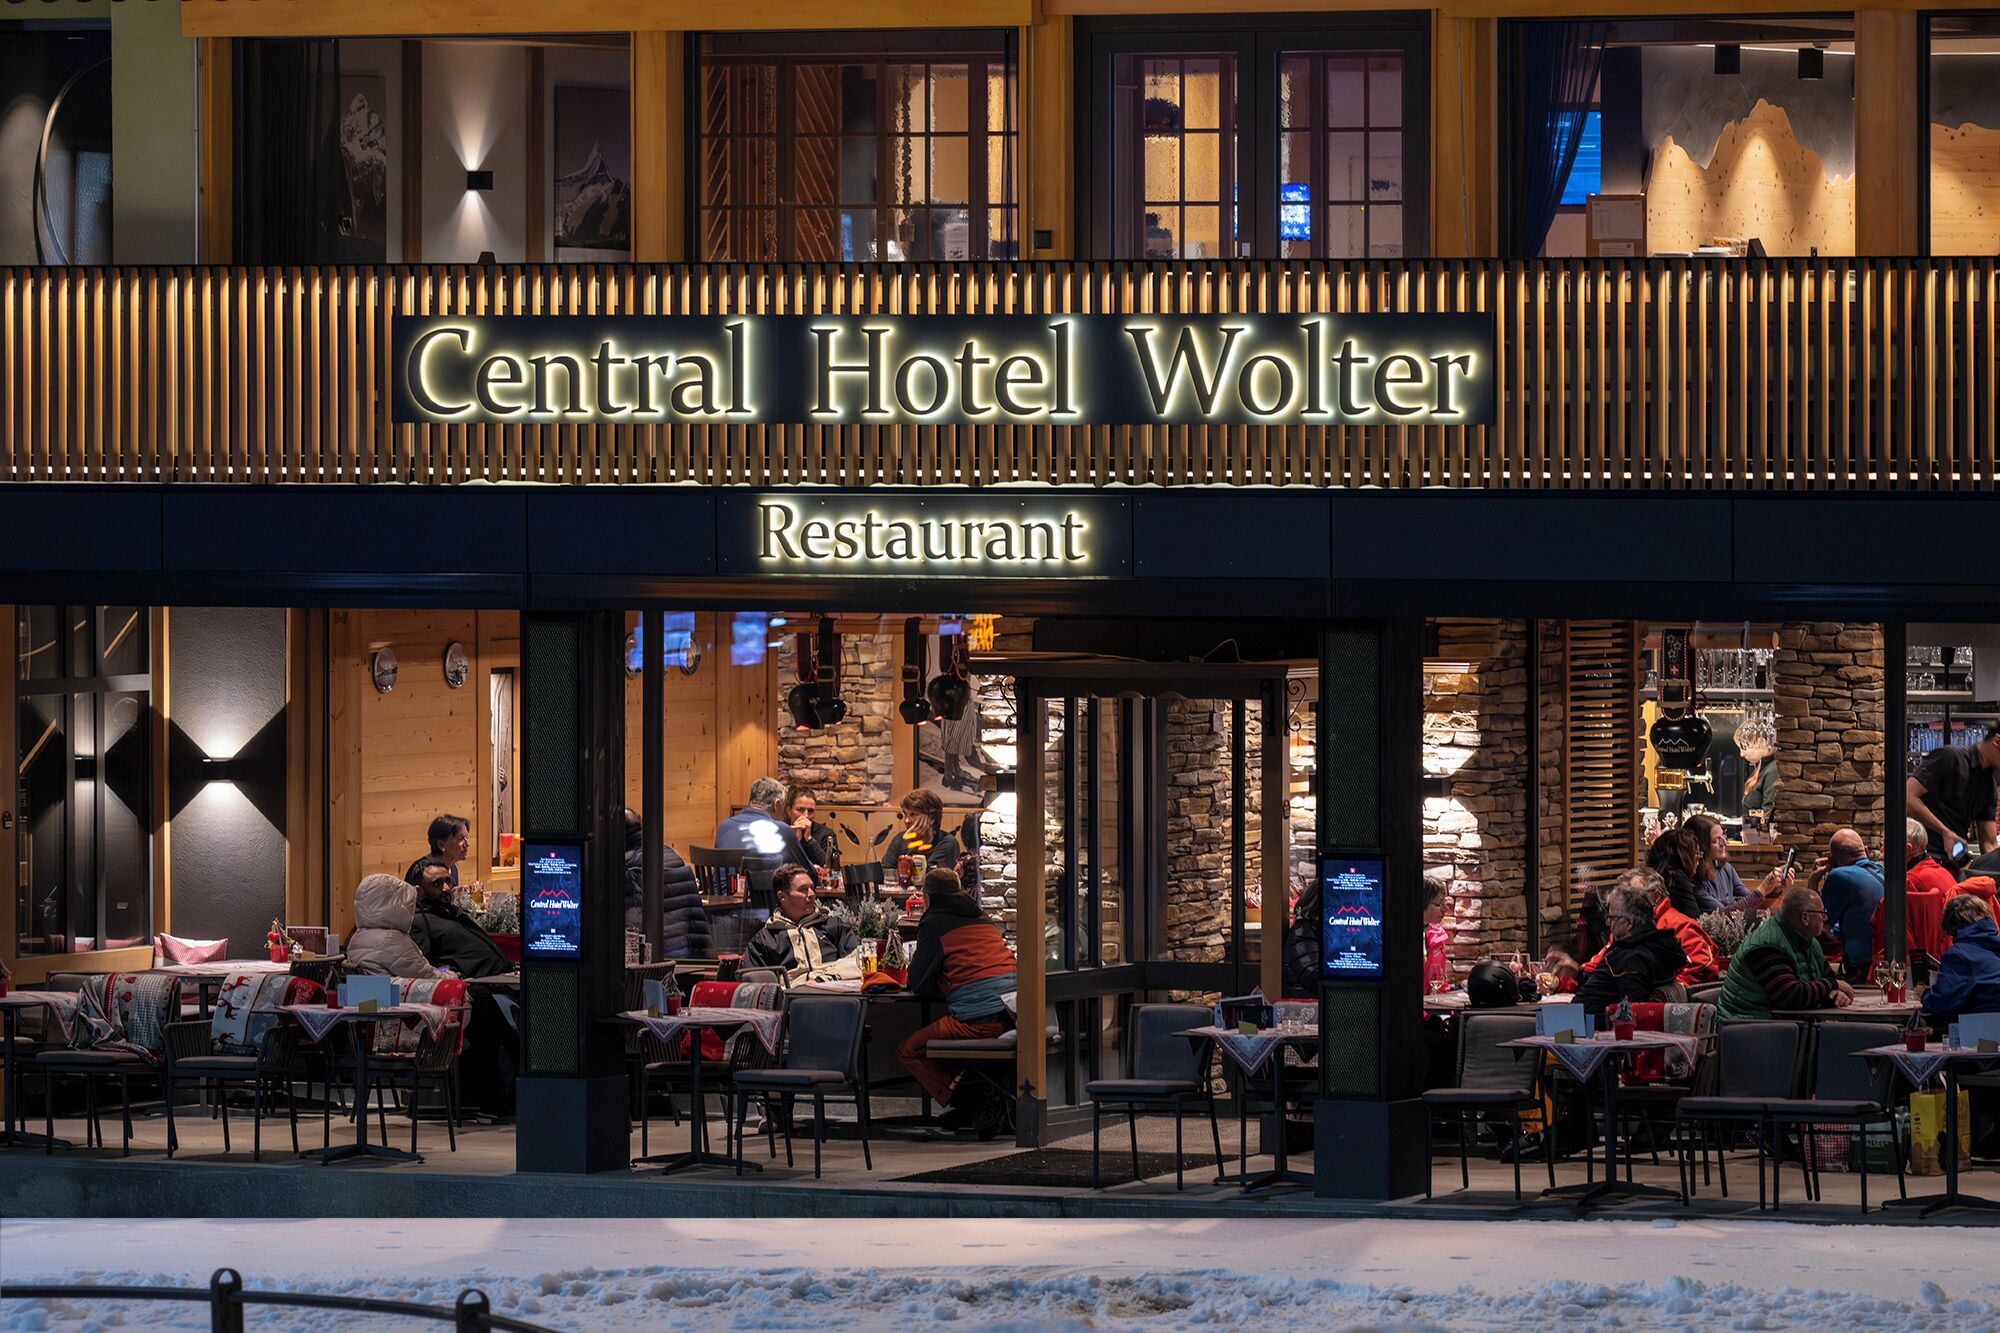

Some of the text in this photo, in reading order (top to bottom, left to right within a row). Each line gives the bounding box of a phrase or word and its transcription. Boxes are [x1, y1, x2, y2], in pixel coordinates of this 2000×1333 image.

[406, 320, 1475, 416] Central Hotel Wolter
[759, 501, 1087, 562] Restaurant
[530, 899, 549, 909] Central
[549, 899, 562, 909] Hotel
[1329, 916, 1348, 926] Central
[1349, 916, 1362, 926] Hotel
